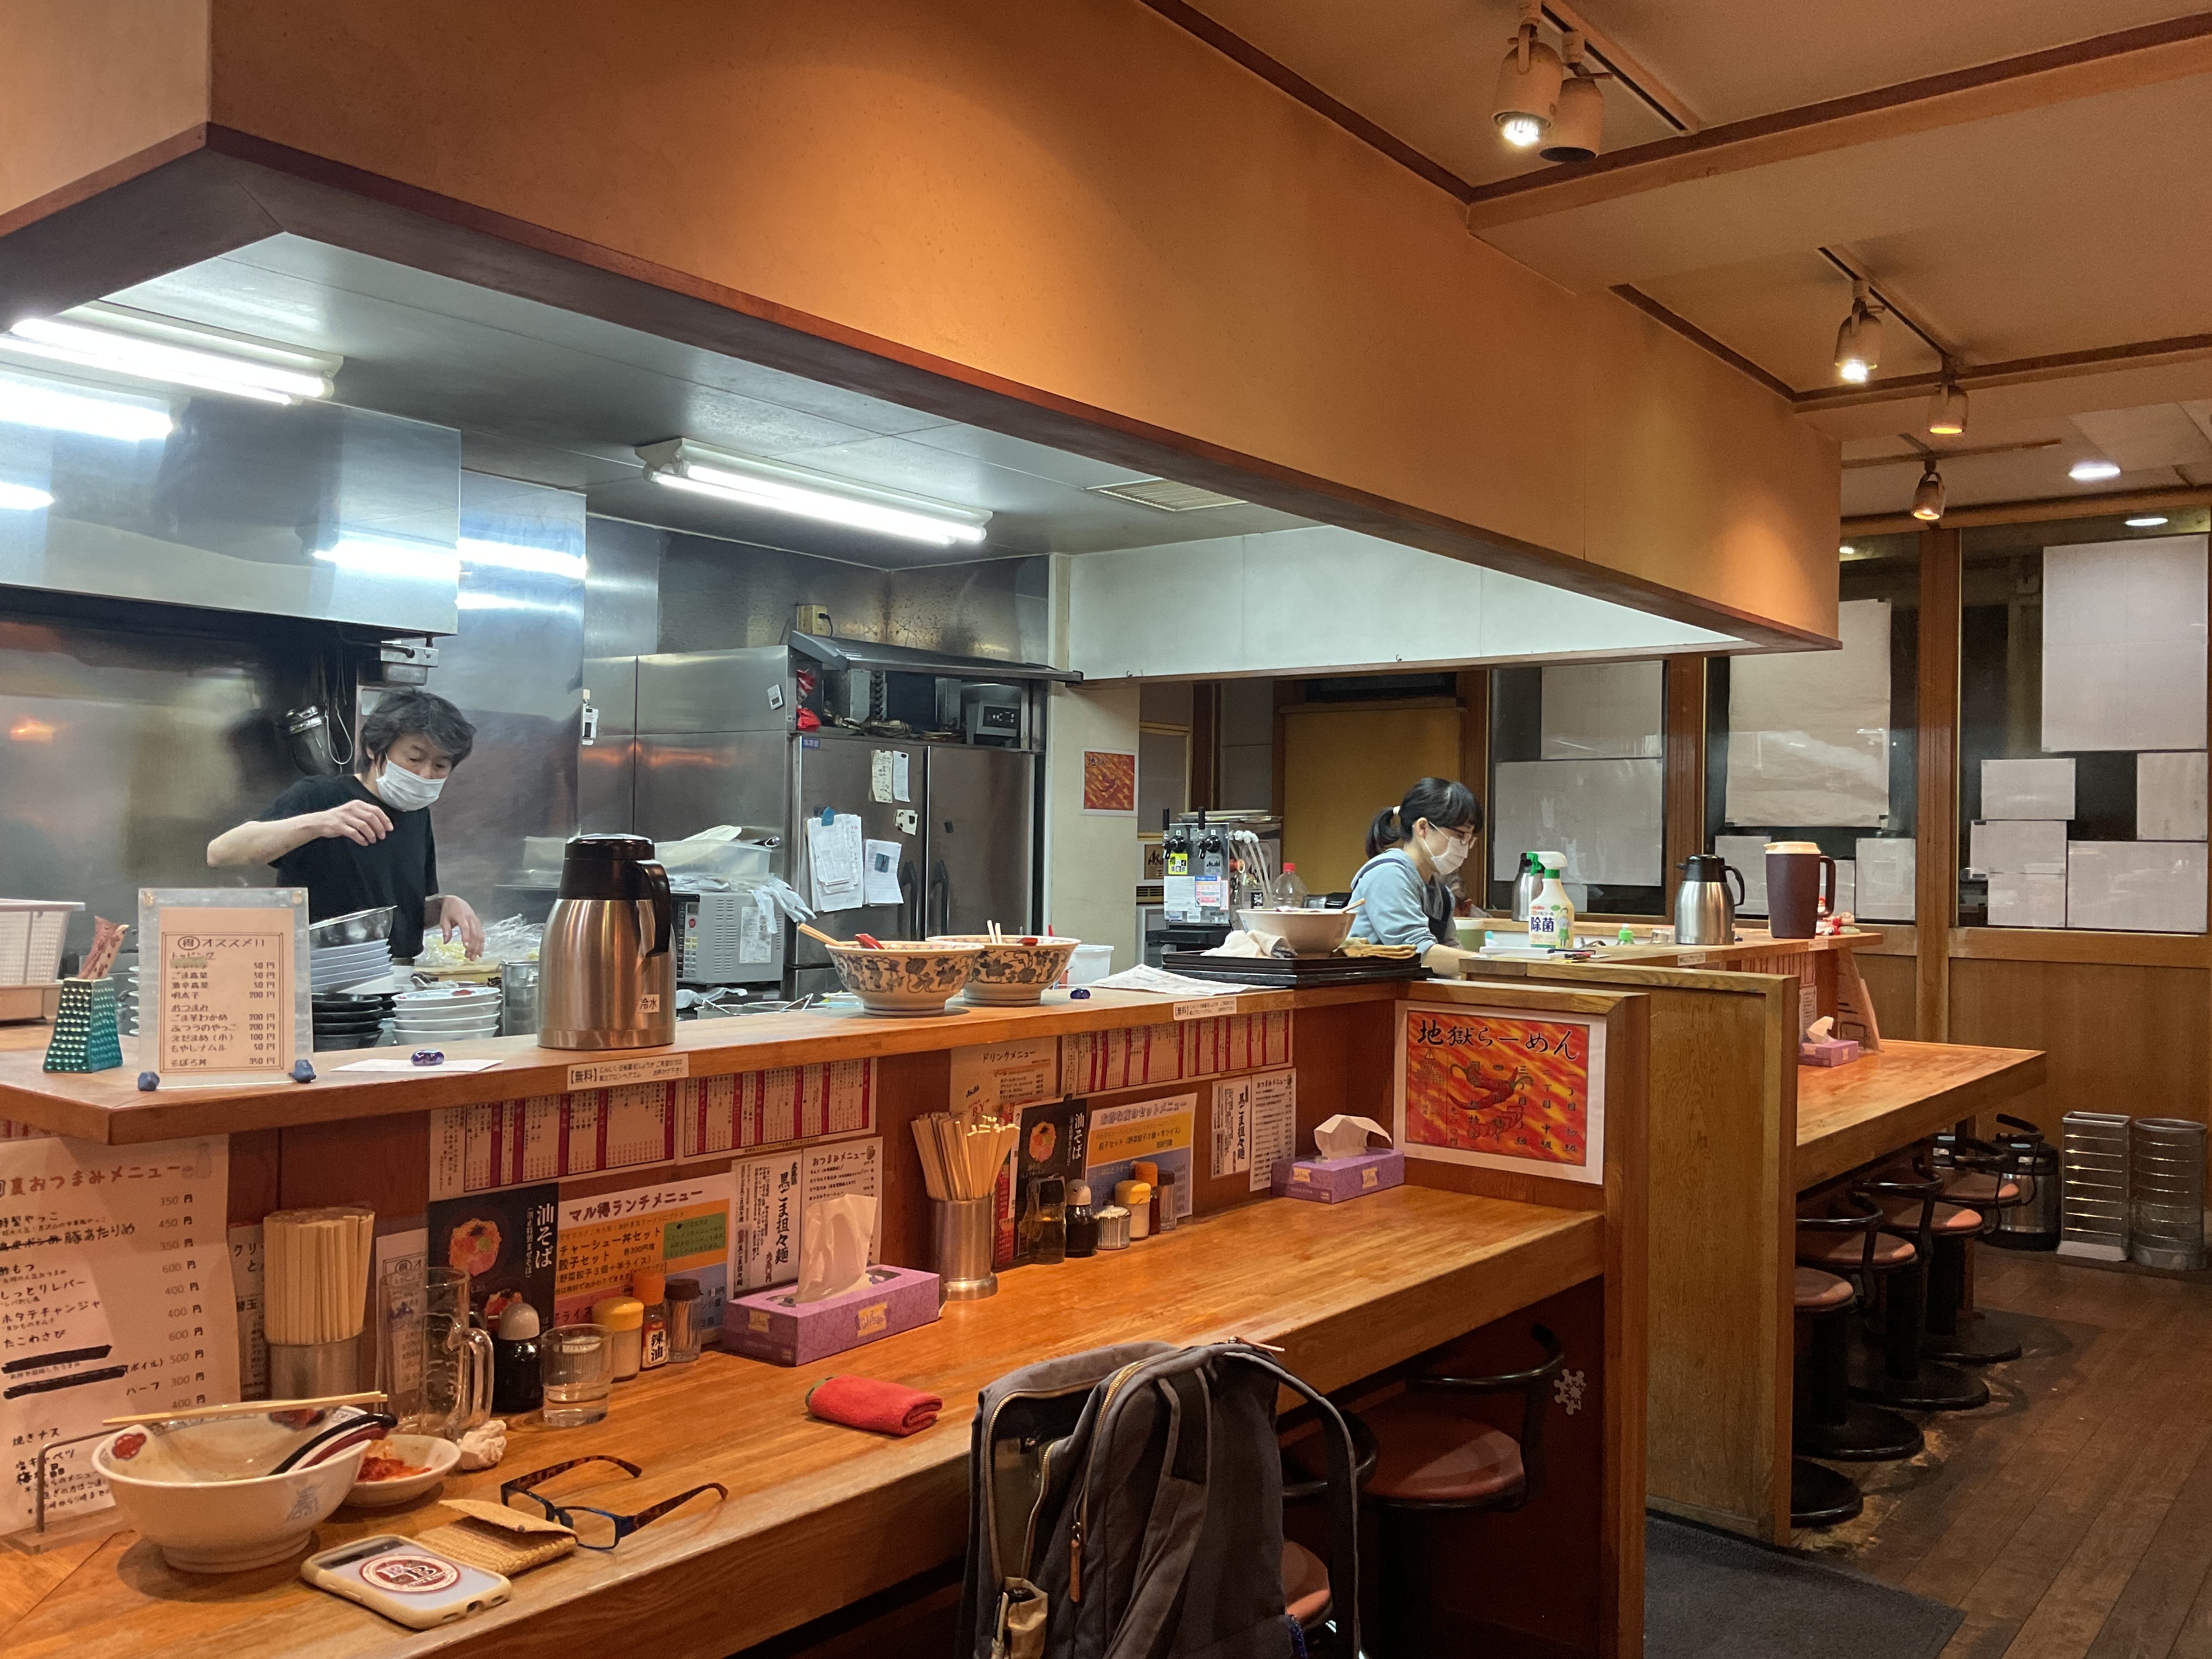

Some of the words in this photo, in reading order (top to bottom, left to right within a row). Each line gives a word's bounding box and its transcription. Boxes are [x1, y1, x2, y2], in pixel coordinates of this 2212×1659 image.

[1531, 917, 1554, 932] 除菌
[640, 997, 657, 1010] 冷水
[171, 1024, 236, 1032] ふつうのやっこ
[1417, 1019, 1580, 1060] 地獄らーめん
[171, 1044, 226, 1052] もやしナムル
[983, 1051, 1036, 1063] ドリンクメニュー
[571, 1068, 597, 1084] 【無料】
[812, 1152, 866, 1166] おつまみメニュー
[184, 1194, 193, 1203] 円
[569, 1190, 703, 1222] マル得ランチメニュー
[159, 1218, 178, 1228] 450
[184, 1216, 193, 1225] 円
[775, 1172, 790, 1265] 黒ごま担々麺
[65, 1222, 135, 1244] 豚あたりめ
[160, 1240, 179, 1250] 350
[184, 1238, 194, 1248] 円
[560, 1227, 661, 1256] チャーシュー丼セット
[234, 1243, 264, 1257] クリ
[162, 1263, 182, 1273] 600
[187, 1260, 196, 1269] 円
[558, 1250, 610, 1271] 餃子セット
[1, 1279, 86, 1300] しっとりレバー
[165, 1285, 184, 1295] 400
[190, 1282, 199, 1291] 円
[2, 1301, 100, 1324] ホタテチャンジャ
[168, 1307, 187, 1317] 400
[193, 1305, 202, 1314] 円
[3, 1329, 66, 1348] たこわさび
[168, 1330, 189, 1340] 600
[194, 1327, 203, 1337] 円
[170, 1353, 189, 1364] 500
[195, 1350, 204, 1359] 円
[126, 1381, 160, 1396] ハーフ
[171, 1375, 190, 1386] 300
[195, 1372, 205, 1381] 円
[172, 1397, 191, 1409] 400
[196, 1395, 206, 1404] 円
[13, 1427, 60, 1447] 焼きナス
